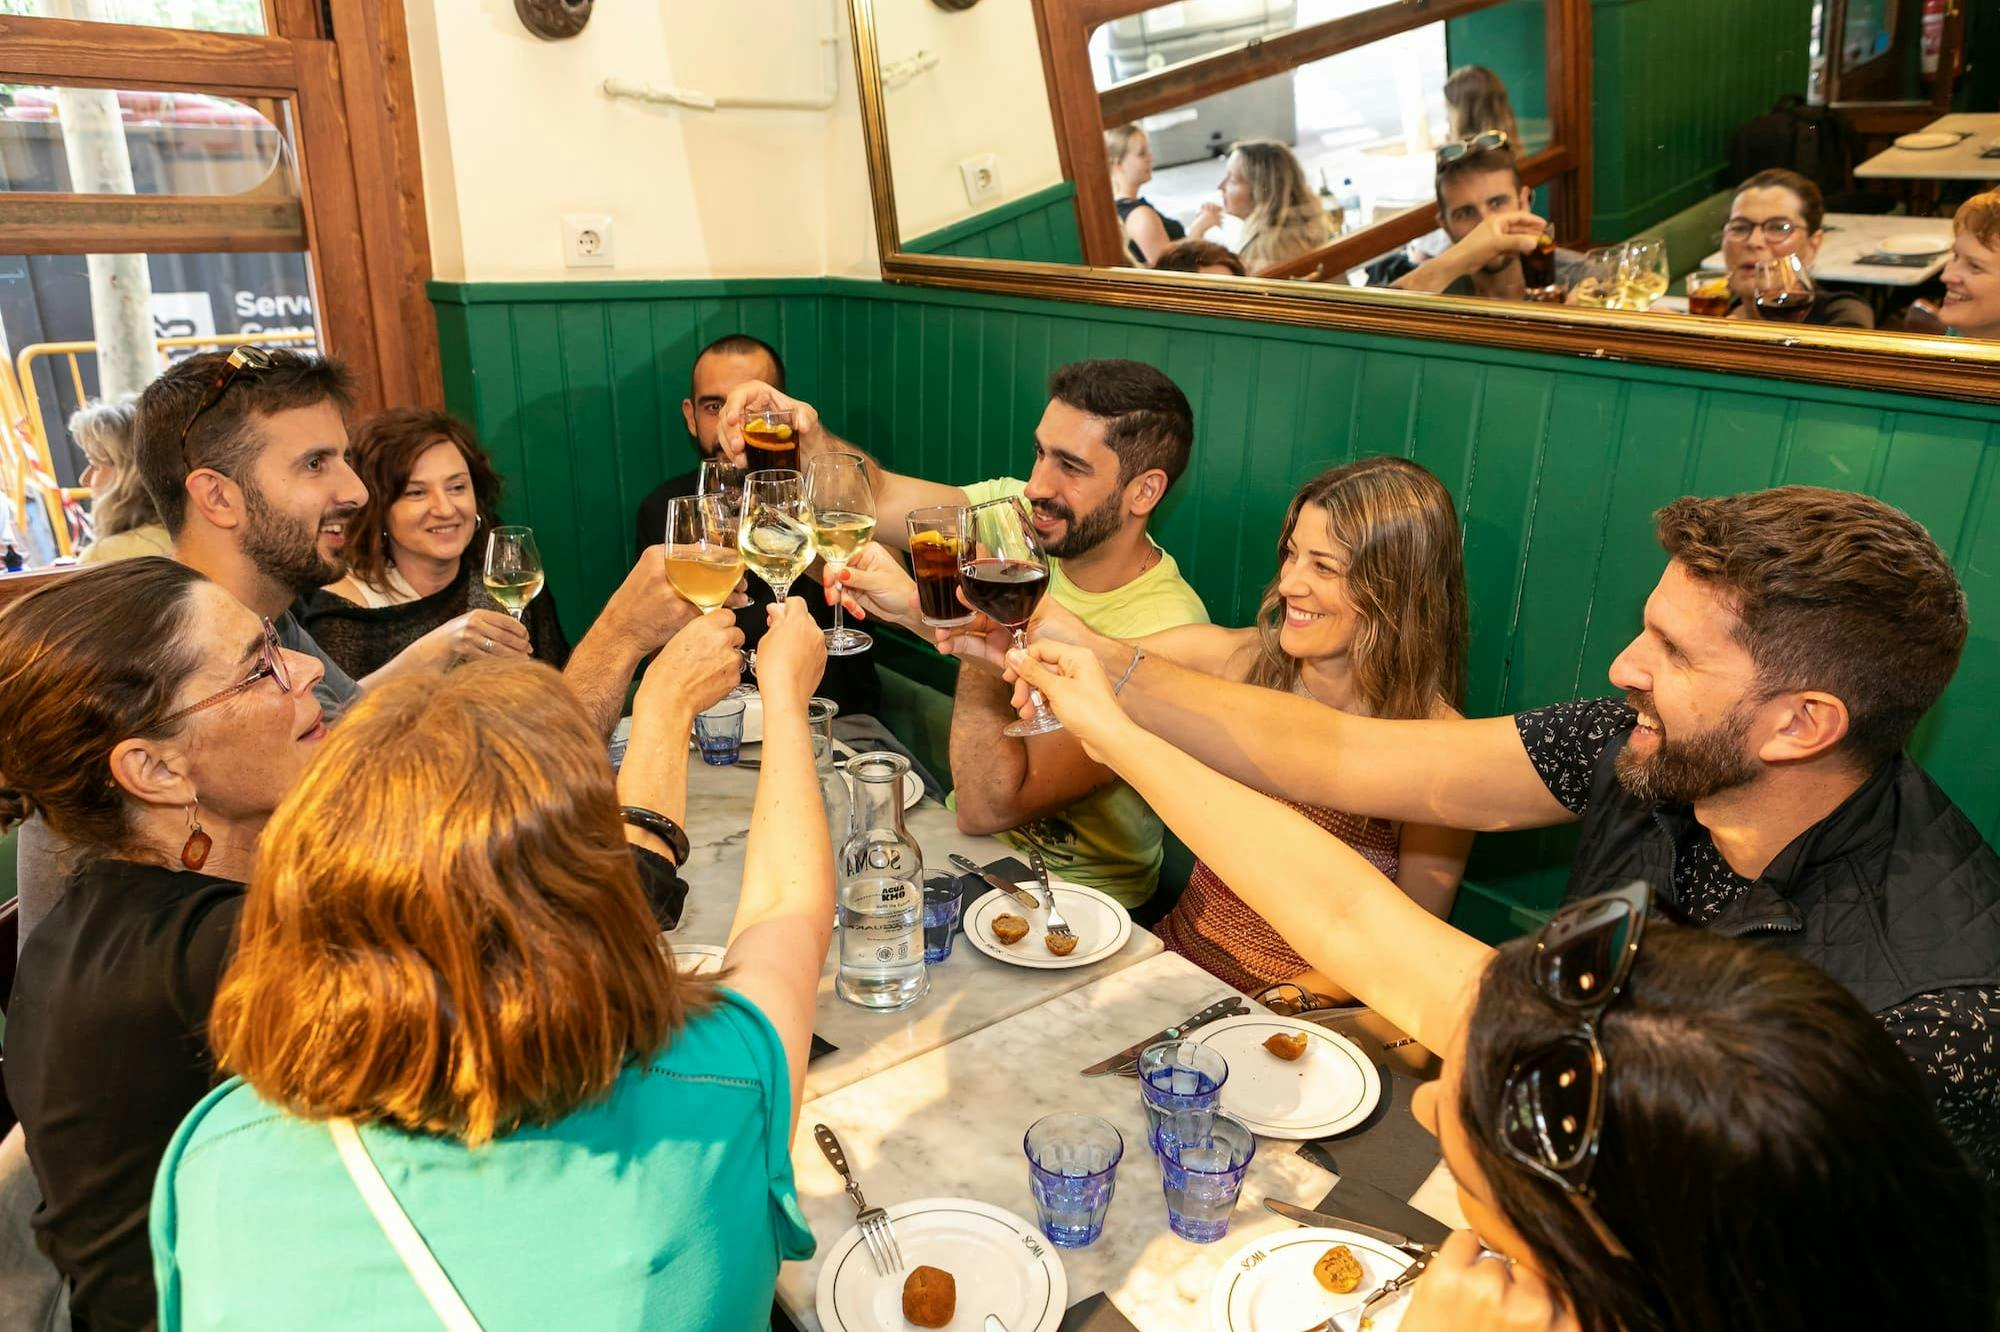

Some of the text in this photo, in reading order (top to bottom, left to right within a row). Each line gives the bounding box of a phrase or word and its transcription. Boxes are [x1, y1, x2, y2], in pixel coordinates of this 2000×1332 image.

[882, 884, 905, 894] AGUA
[1021, 1235, 1045, 1259] SOMA
[1240, 1249, 1267, 1271] SOMA
